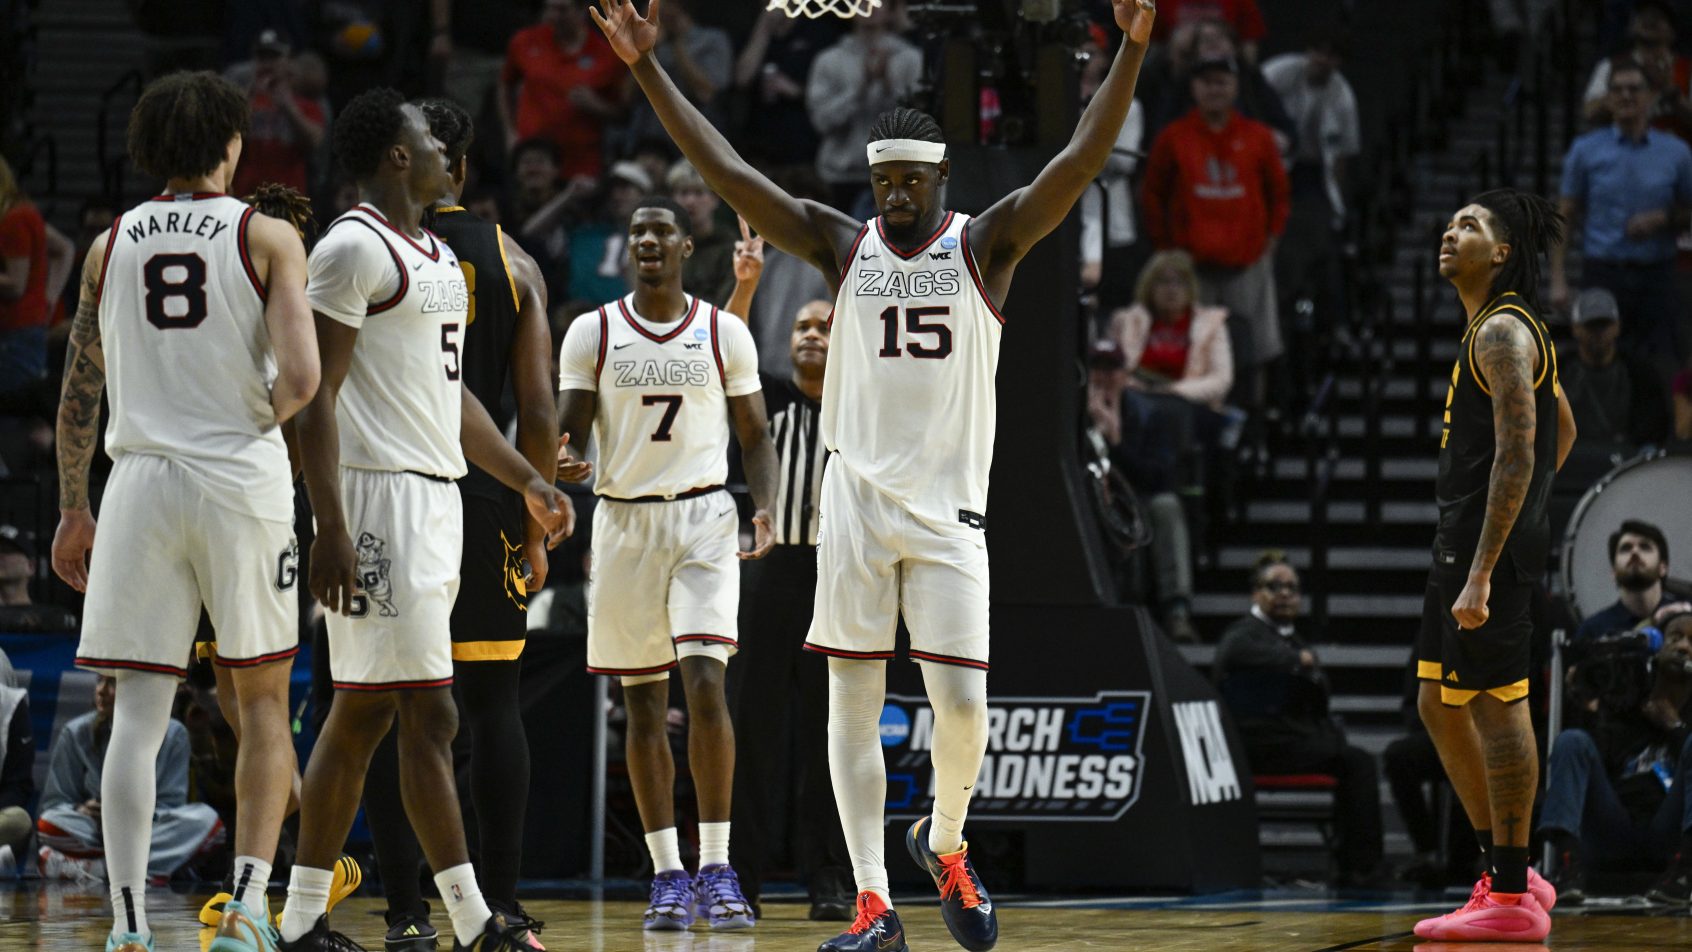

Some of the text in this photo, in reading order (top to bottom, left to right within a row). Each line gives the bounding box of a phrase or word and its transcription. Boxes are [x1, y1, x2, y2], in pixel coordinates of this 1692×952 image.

[127, 212, 228, 243] WARLEY
[144, 252, 208, 330] 8
[856, 268, 960, 298] ZAGS
[441, 323, 459, 381] 5
[879, 305, 953, 359] 15
[614, 360, 710, 387] ZAGS
[641, 393, 684, 442] 7
[909, 707, 1065, 751] MRCH
[928, 754, 1136, 799] ADNESS
